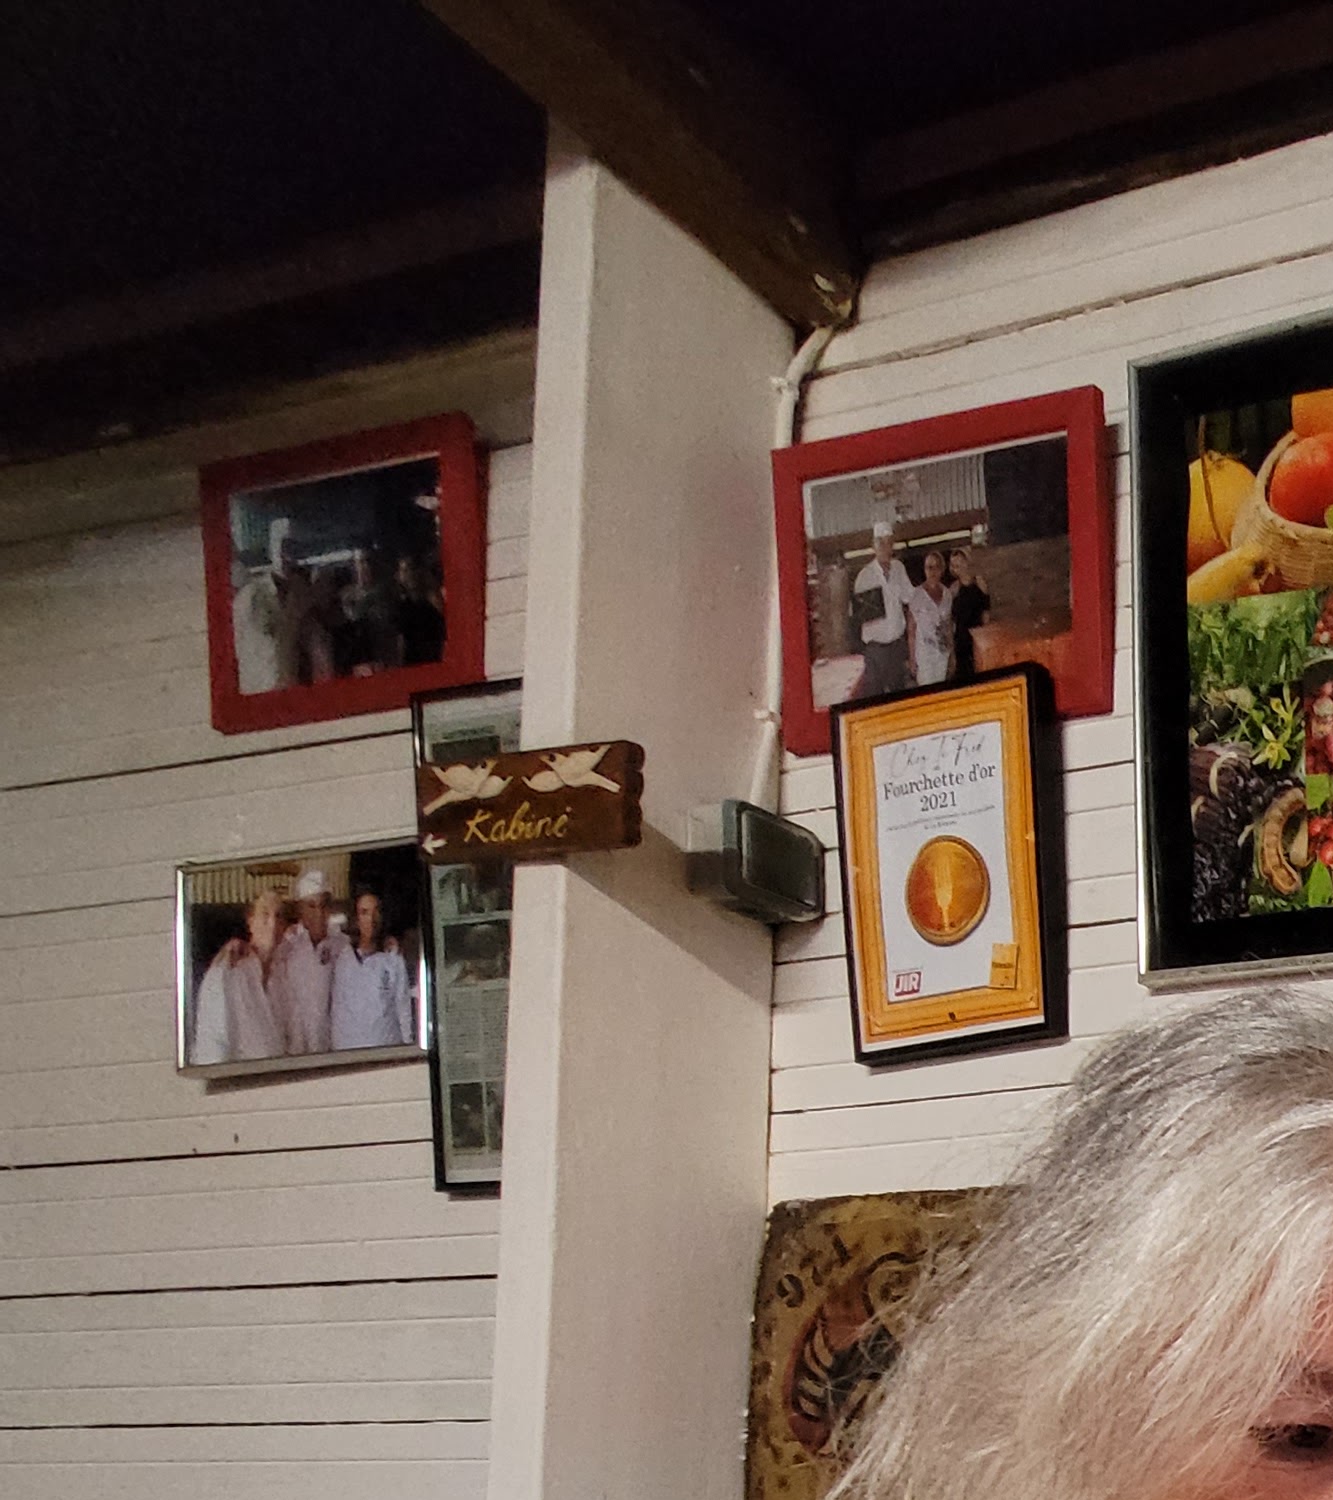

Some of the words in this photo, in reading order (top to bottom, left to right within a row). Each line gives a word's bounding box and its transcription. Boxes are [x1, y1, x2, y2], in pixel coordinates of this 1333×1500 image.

[882, 772, 966, 801] Fourchette
[968, 763, 997, 783] d'or
[919, 790, 957, 813] 2021
[895, 972, 920, 994] JIR
